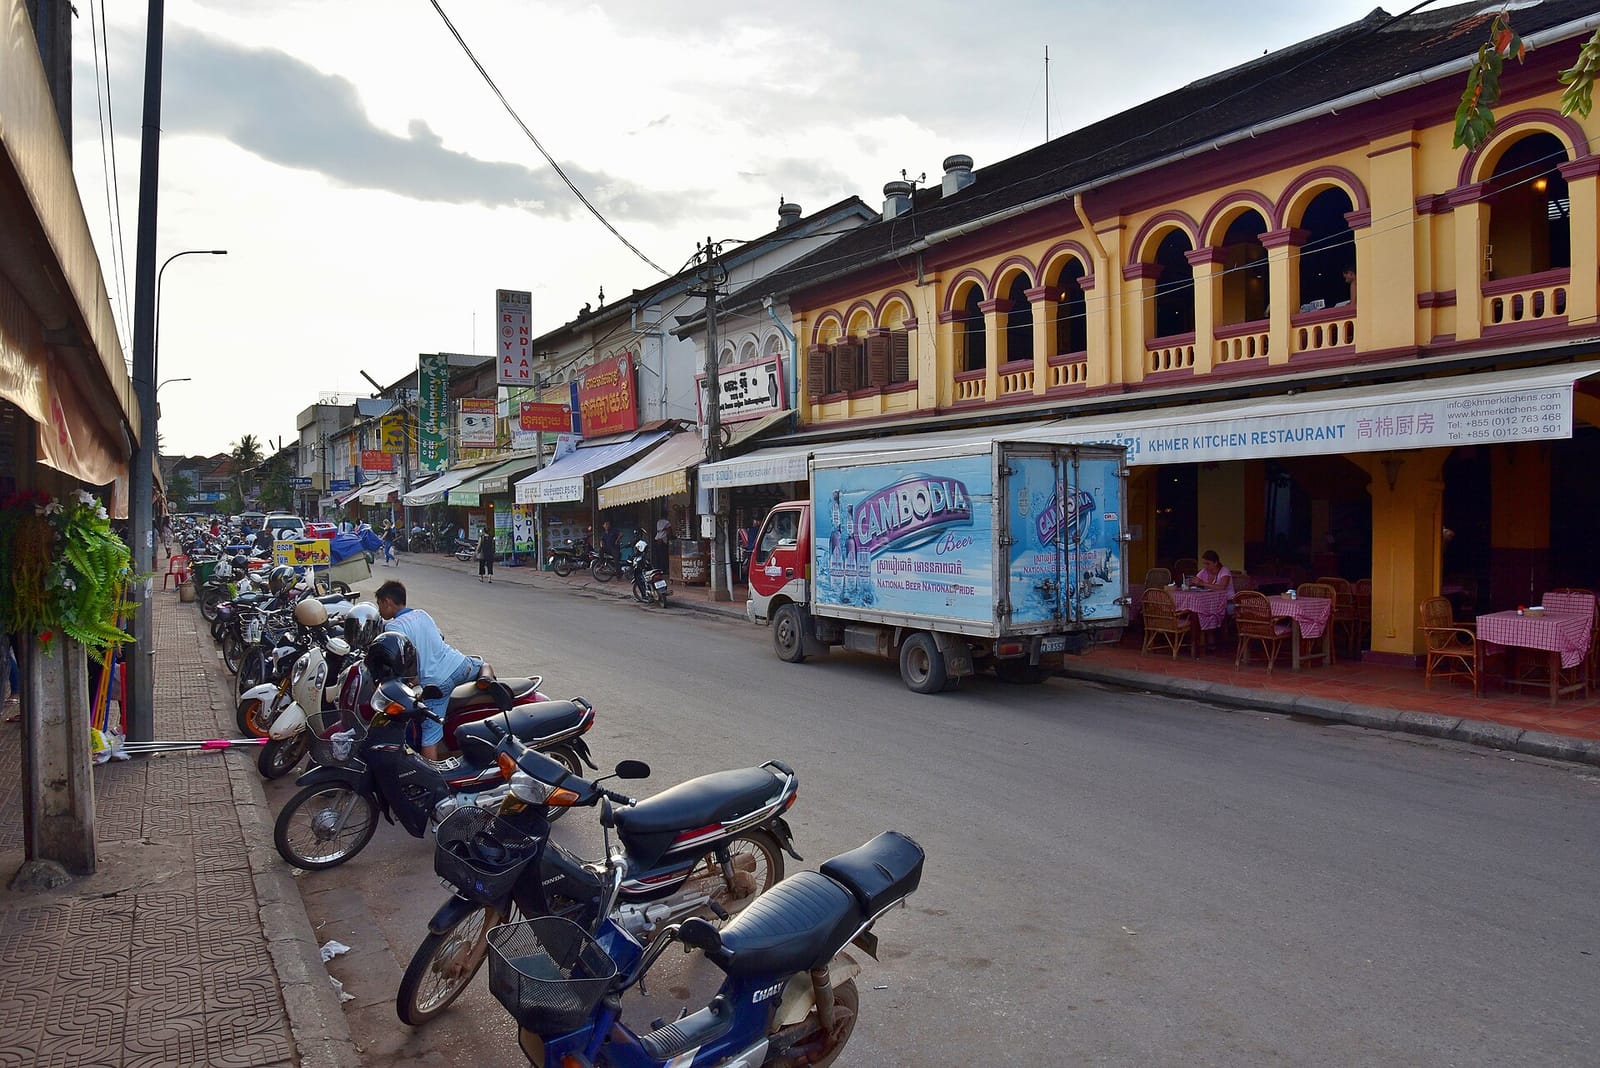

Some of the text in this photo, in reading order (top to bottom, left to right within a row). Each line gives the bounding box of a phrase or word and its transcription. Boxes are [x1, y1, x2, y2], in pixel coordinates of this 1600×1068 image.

[519, 315, 529, 378] INDIAN
[1447, 392, 1561, 409] info@khmerkitchens.com
[1447, 403, 1561, 419] www.khmerkitchens.com
[1356, 412, 1435, 440] 高棉厨房
[1448, 412, 1561, 429] Tel: +855 (0)12 763 468
[1448, 423, 1561, 440] Tel: +855 (0)12 349 501
[1149, 424, 1346, 452] KHMER KITCHEN RESTAURANT
[857, 480, 969, 545] CAMBODIA
[936, 530, 974, 555] Beer
[877, 579, 975, 596] NATIONAL BEER NATIONAL PRIDE
[752, 981, 784, 1004] CHALY
